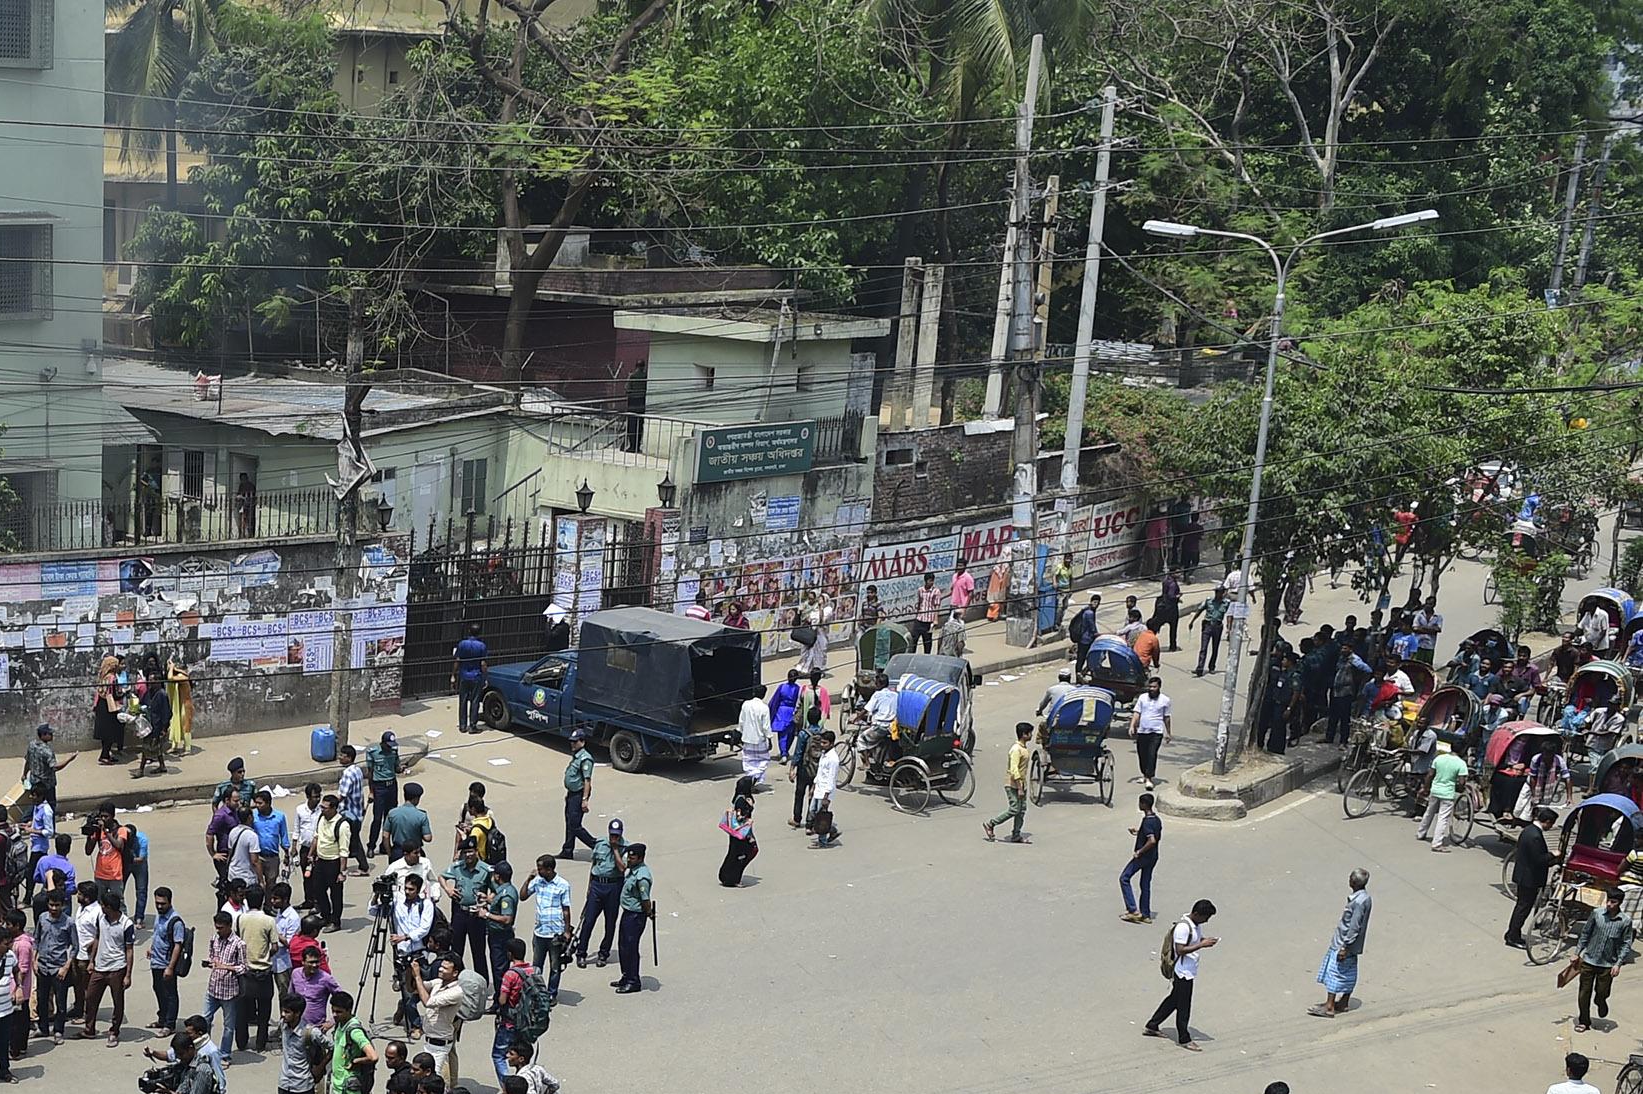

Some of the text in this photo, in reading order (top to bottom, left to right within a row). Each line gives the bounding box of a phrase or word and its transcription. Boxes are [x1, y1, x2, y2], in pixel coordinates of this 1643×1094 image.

[708, 447, 804, 465] জাতীয় সঞ্চয় অধিদপ্তর
[1094, 506, 1140, 539] UCC
[863, 545, 930, 580] MABS
[294, 613, 309, 624] BCS
[319, 612, 334, 622] BCS
[216, 625, 233, 636] BCS
[242, 623, 258, 635] BCS
[267, 622, 283, 633] BCS
[525, 709, 549, 724] পুলিশ
